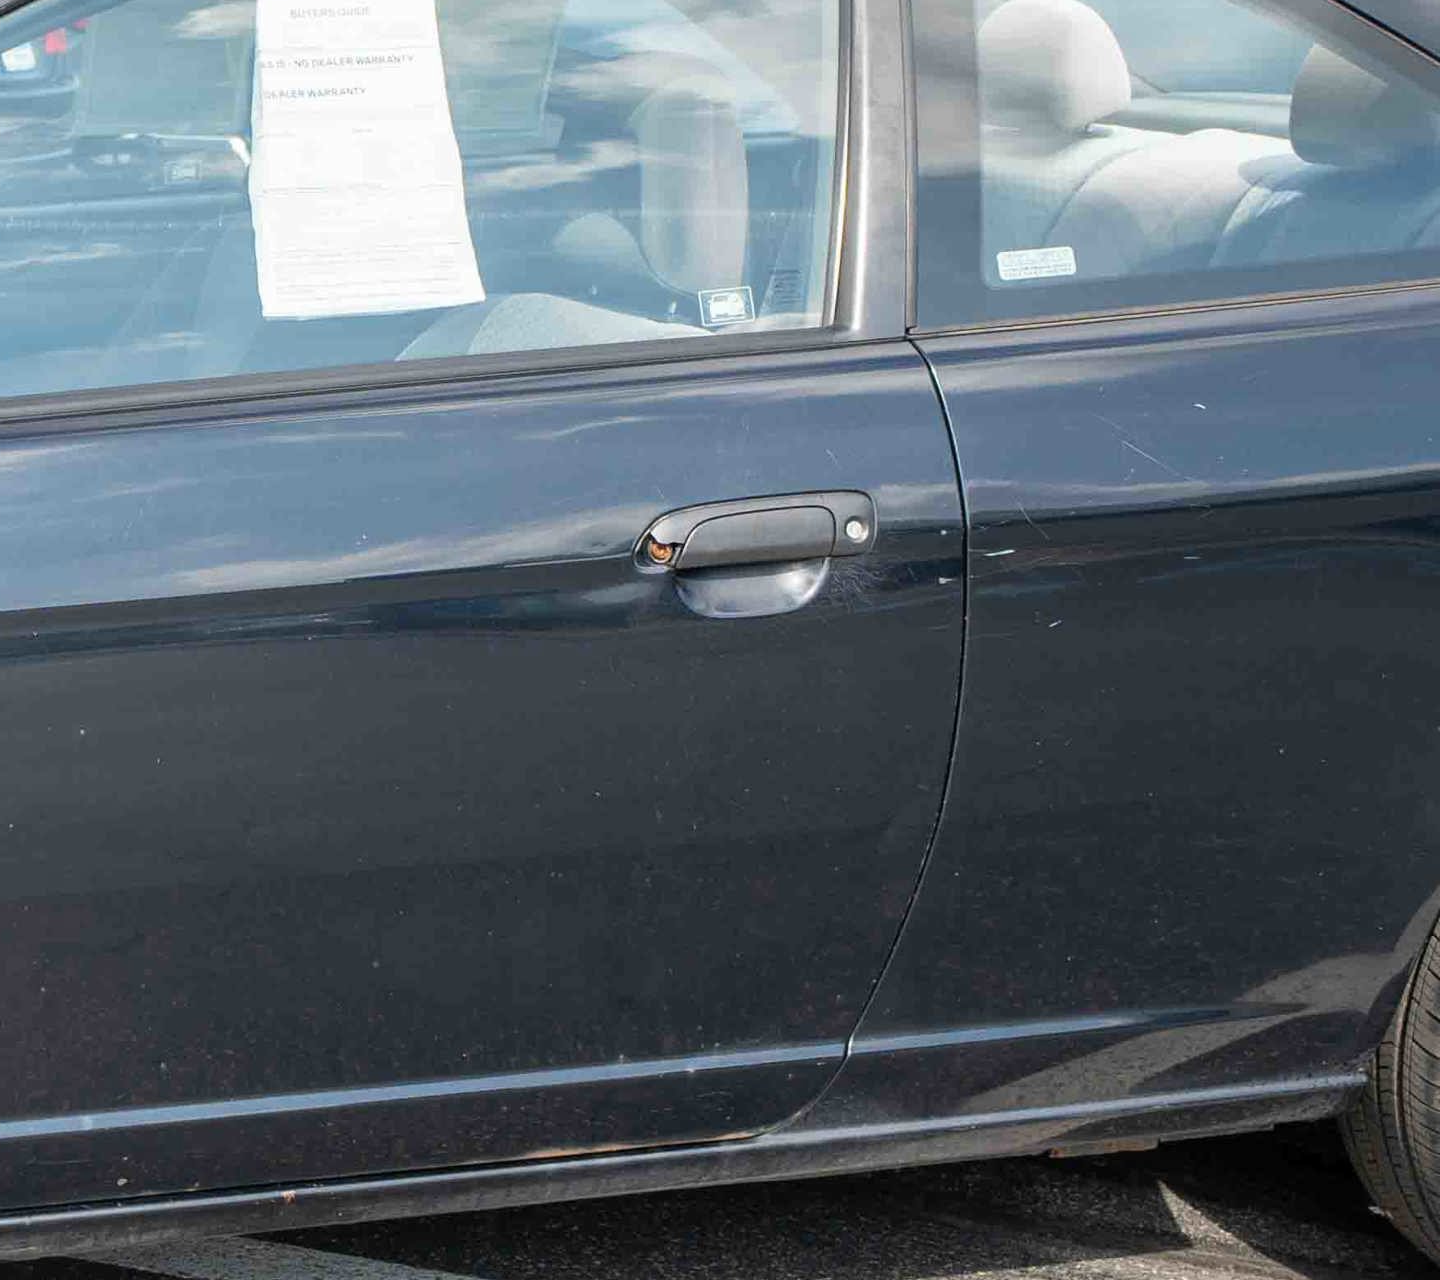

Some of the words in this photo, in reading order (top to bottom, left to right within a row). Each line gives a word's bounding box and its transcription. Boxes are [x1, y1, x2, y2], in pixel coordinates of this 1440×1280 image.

[311, 57, 354, 67] DEALER
[355, 54, 414, 65] WARRANTY
[306, 87, 367, 98] WARRANTY
